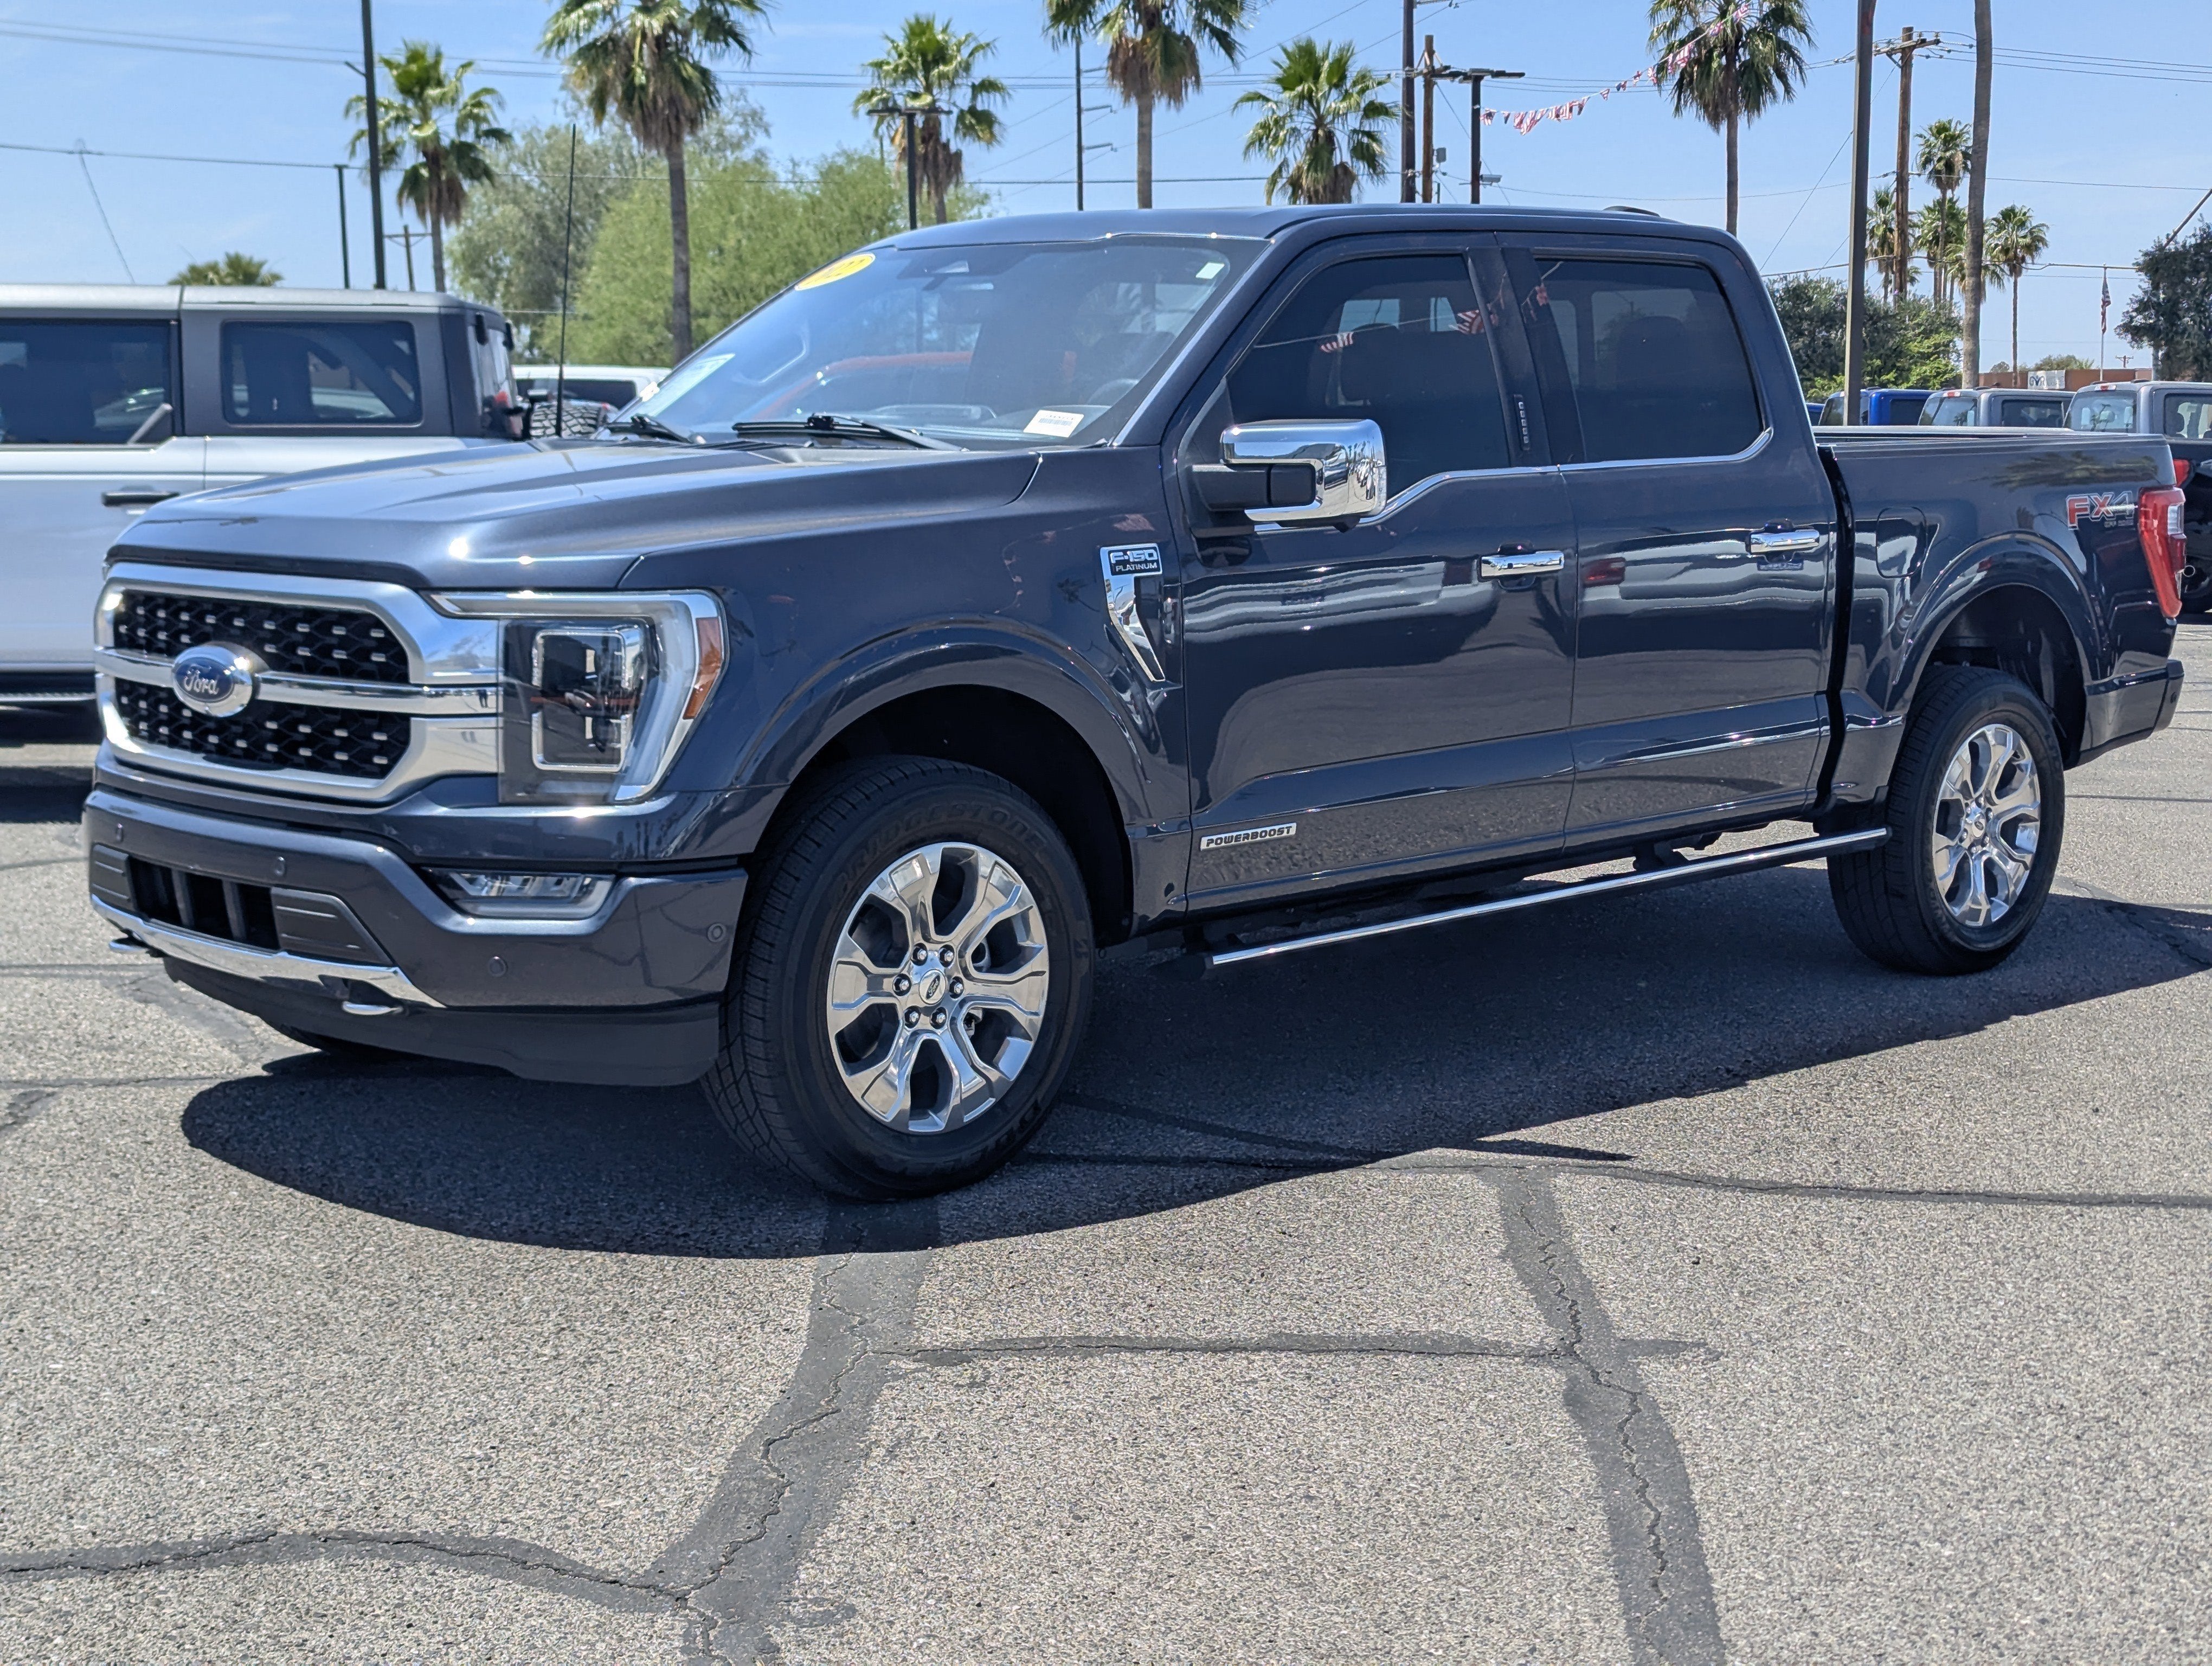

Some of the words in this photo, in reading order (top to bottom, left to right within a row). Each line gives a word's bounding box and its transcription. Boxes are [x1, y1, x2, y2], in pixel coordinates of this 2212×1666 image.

[2066, 490, 2134, 530] FX4
[1110, 549, 1158, 564] F-150
[1115, 562, 1158, 572] PLATINUM
[183, 663, 220, 695] Ford
[1206, 825, 1293, 847] POWERBOOST
[928, 978, 939, 996] Ford
